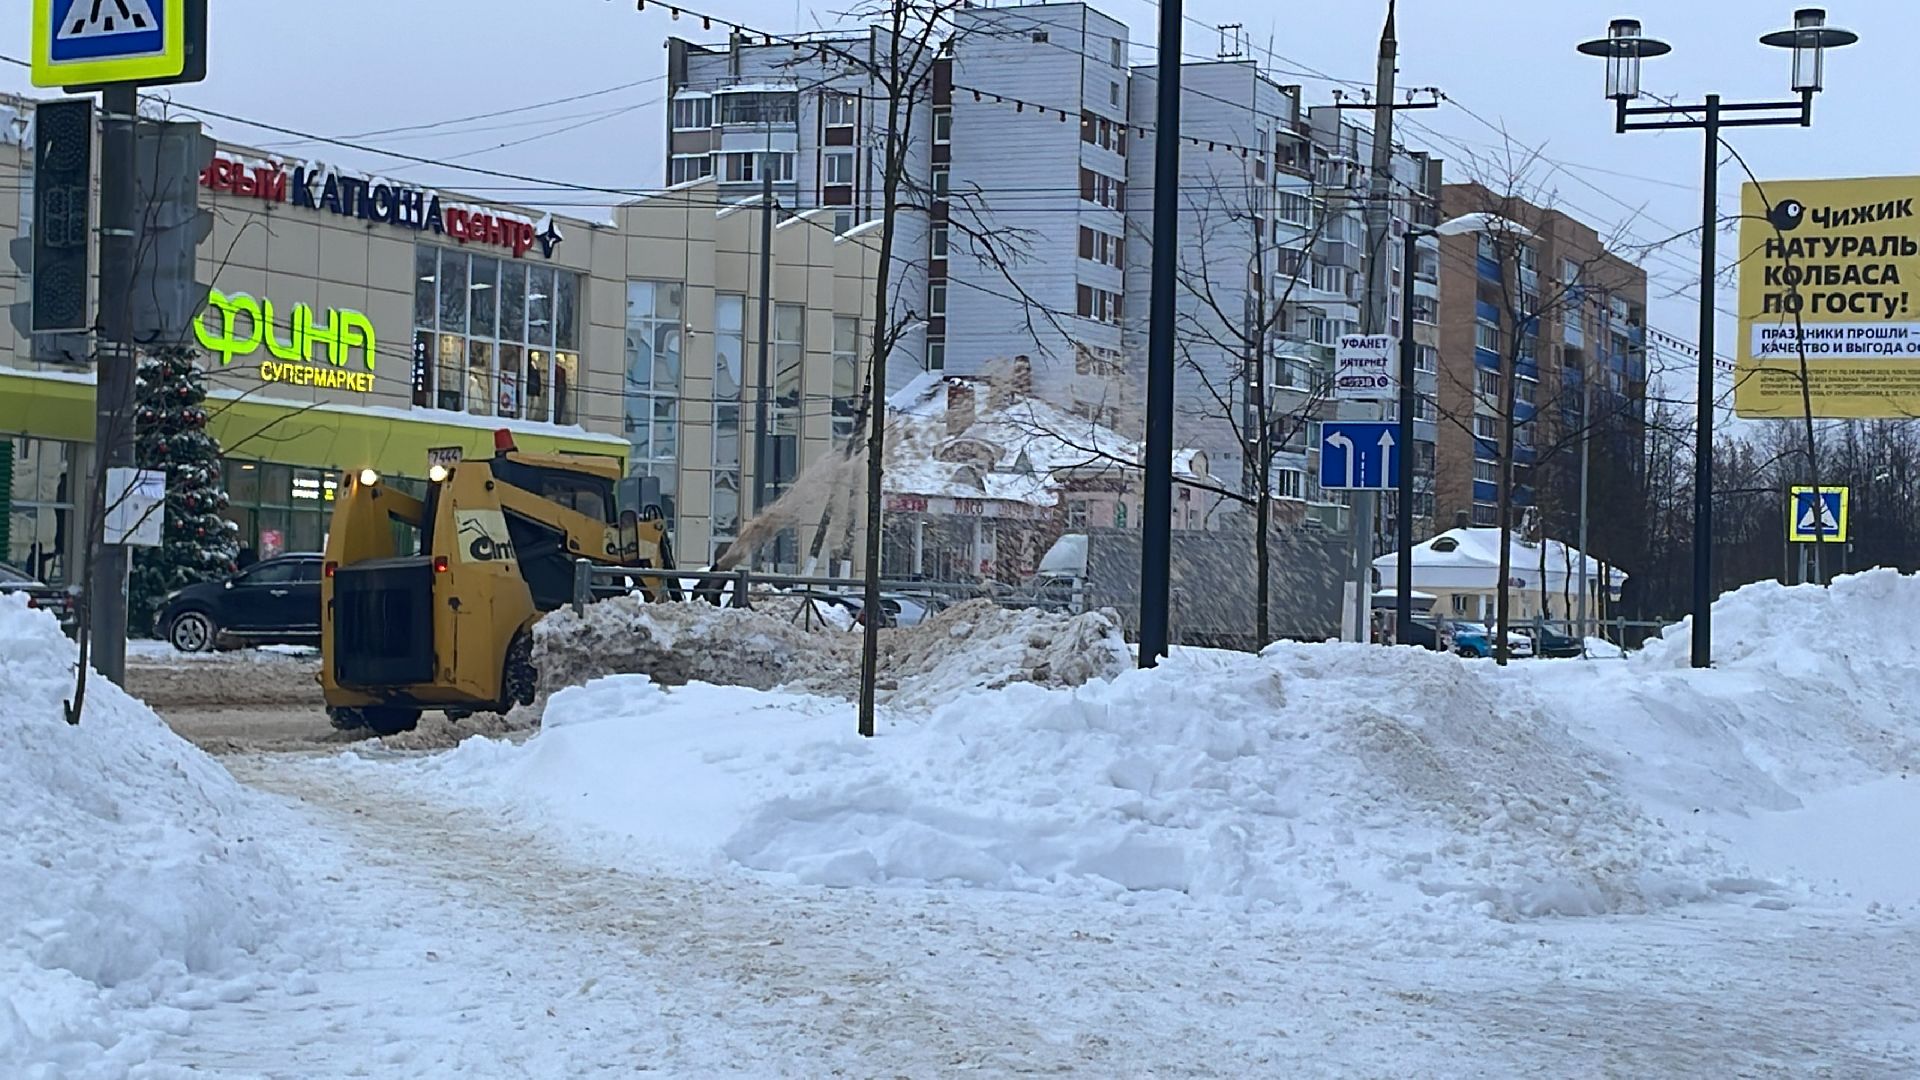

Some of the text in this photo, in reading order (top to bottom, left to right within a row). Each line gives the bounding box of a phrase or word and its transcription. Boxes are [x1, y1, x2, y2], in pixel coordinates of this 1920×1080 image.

[292, 164, 445, 234] КАТЮША
[1765, 235, 1920, 259] НАТУРАЛЬ
[1764, 264, 1900, 286] КОЛБАСА
[1763, 291, 1909, 319] ПО ГОСТу!
[1761, 328, 1844, 340] ПРАЗДНИКИ
[1847, 328, 1908, 339] ПРОШЛИ
[1341, 338, 1388, 349] УФАНЕТ
[1761, 342, 1830, 353] КАЧЕСТВО
[1833, 342, 1843, 353] И
[1846, 342, 1903, 355] ВЫГОДА
[1340, 357, 1388, 367] ИНТЕРНЕТ
[260, 360, 376, 392] СУПЕРМАРКЕТ
[432, 450, 458, 464] 7444
